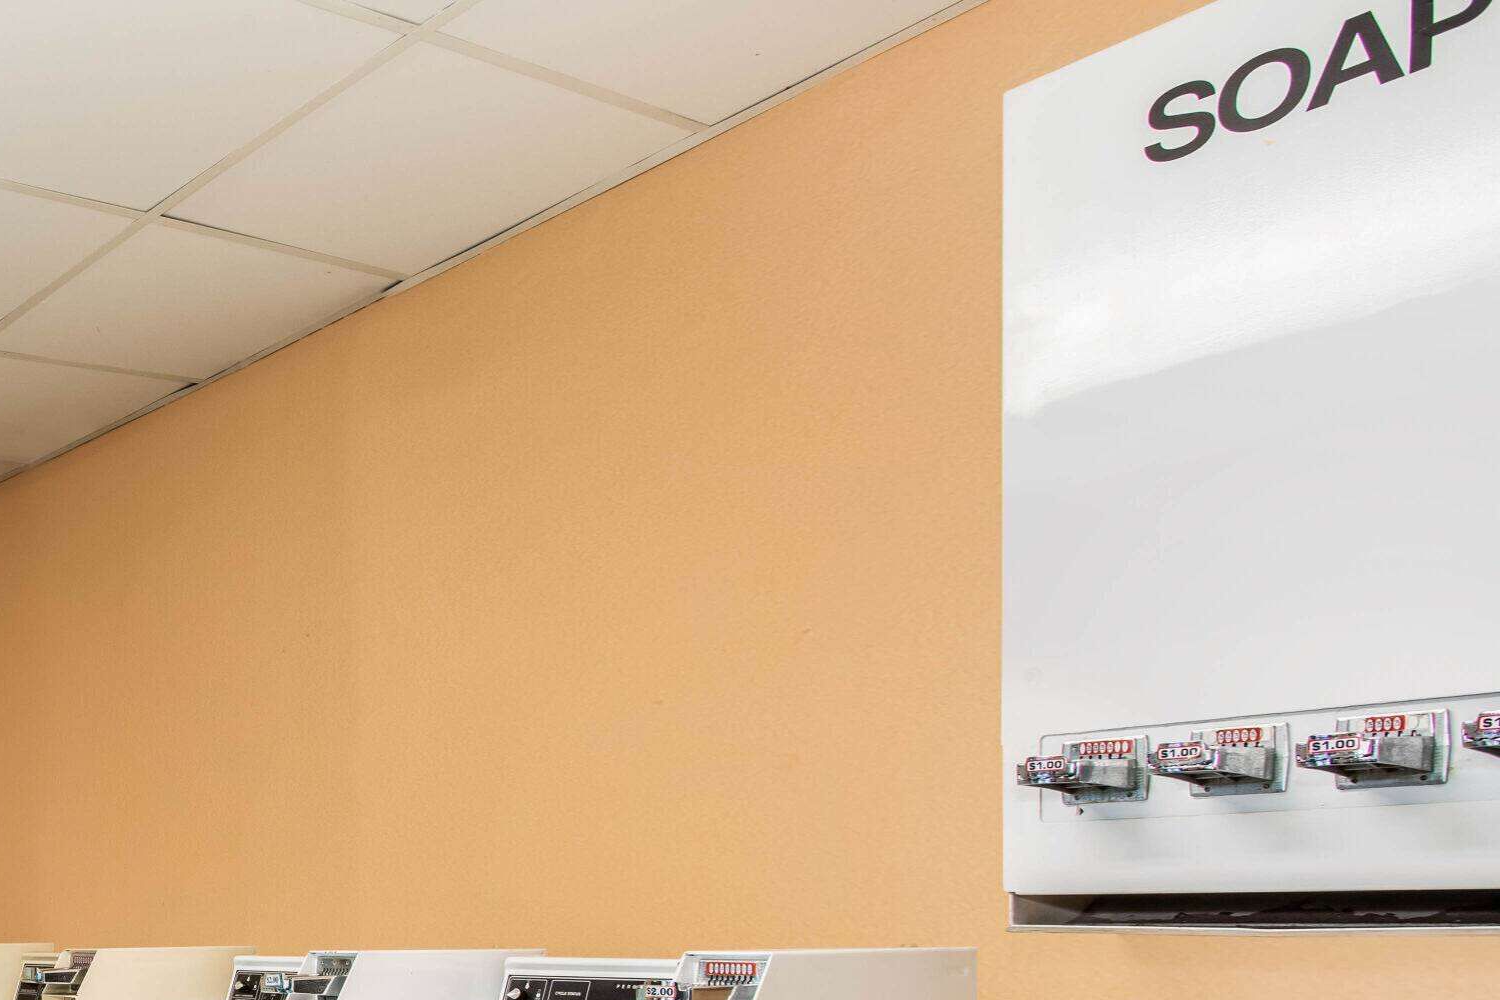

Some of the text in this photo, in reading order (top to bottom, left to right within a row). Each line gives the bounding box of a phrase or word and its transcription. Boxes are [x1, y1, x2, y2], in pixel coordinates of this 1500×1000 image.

[1144, 0, 1493, 163] SOAP
[1311, 739, 1356, 752] $1.00
[1159, 747, 1198, 759] $1.00
[1028, 760, 1063, 771] $1.00
[646, 987, 674, 996] $2.00
